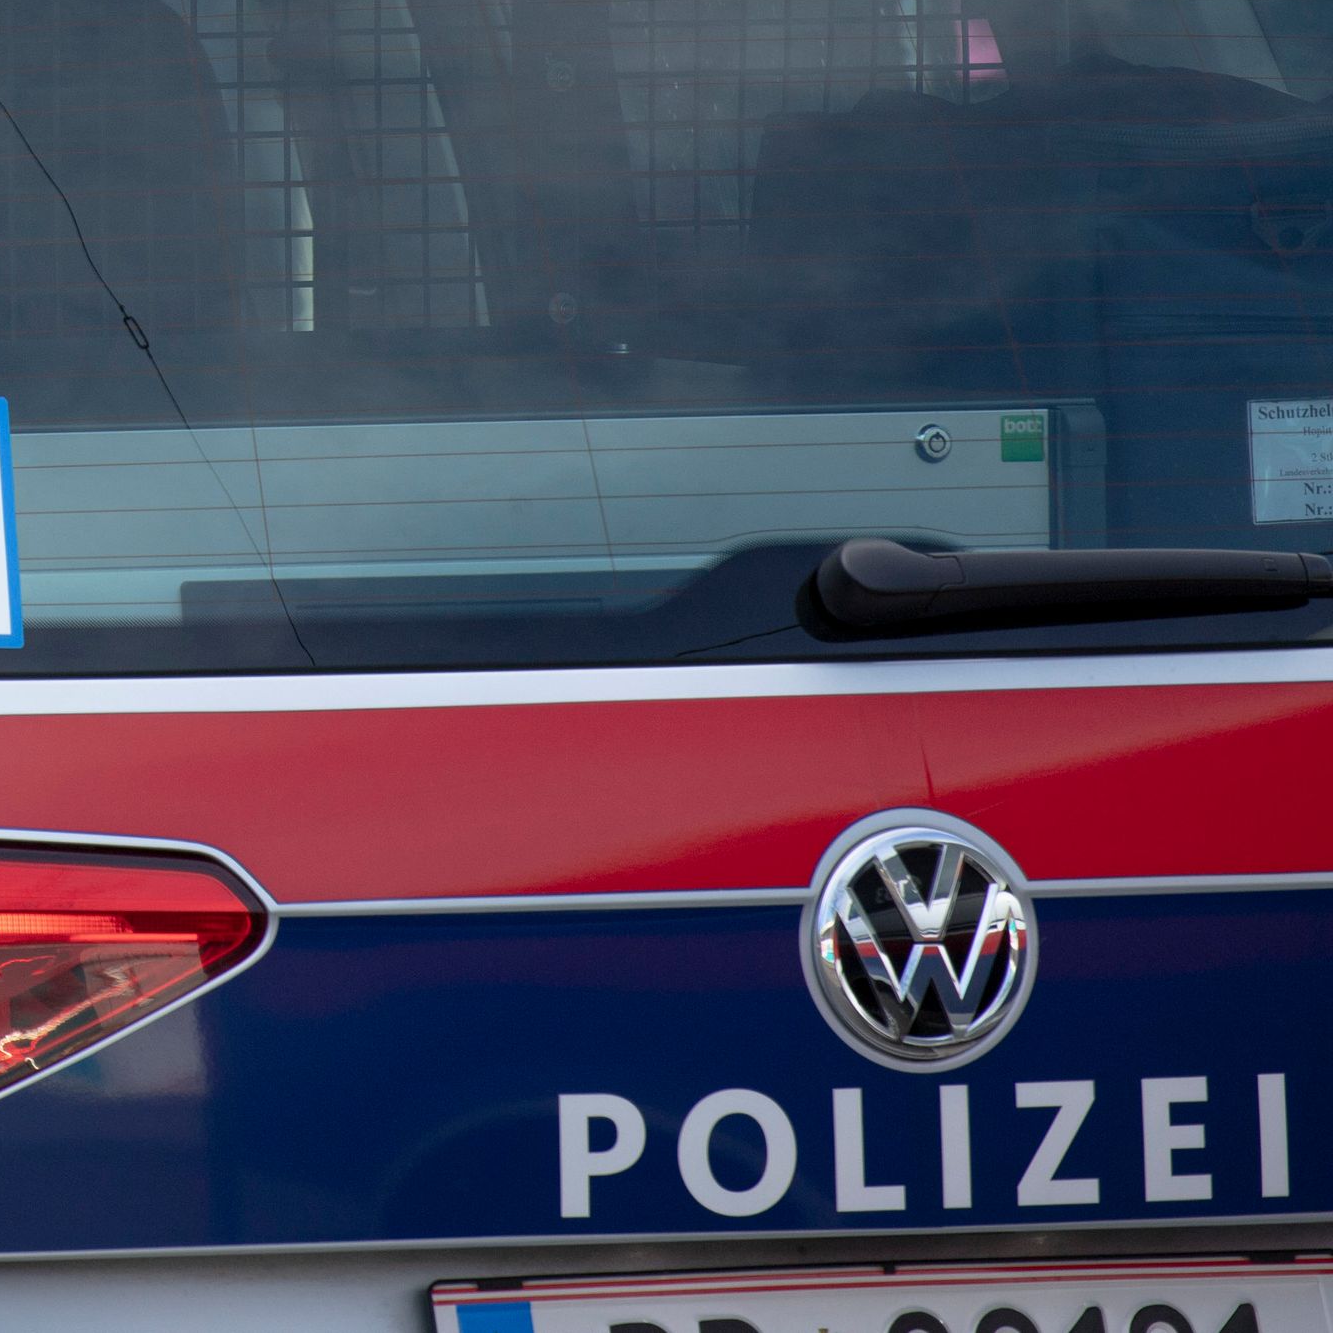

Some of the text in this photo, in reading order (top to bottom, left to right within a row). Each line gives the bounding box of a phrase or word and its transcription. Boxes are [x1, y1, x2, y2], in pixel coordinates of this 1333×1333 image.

[1258, 404, 1333, 420] Schutzhel
[1303, 481, 1332, 495] Nr.:
[1304, 503, 1333, 516] Nr.:
[833, 840, 1016, 1044] VW
[558, 1072, 1290, 1218] POLIZEI
